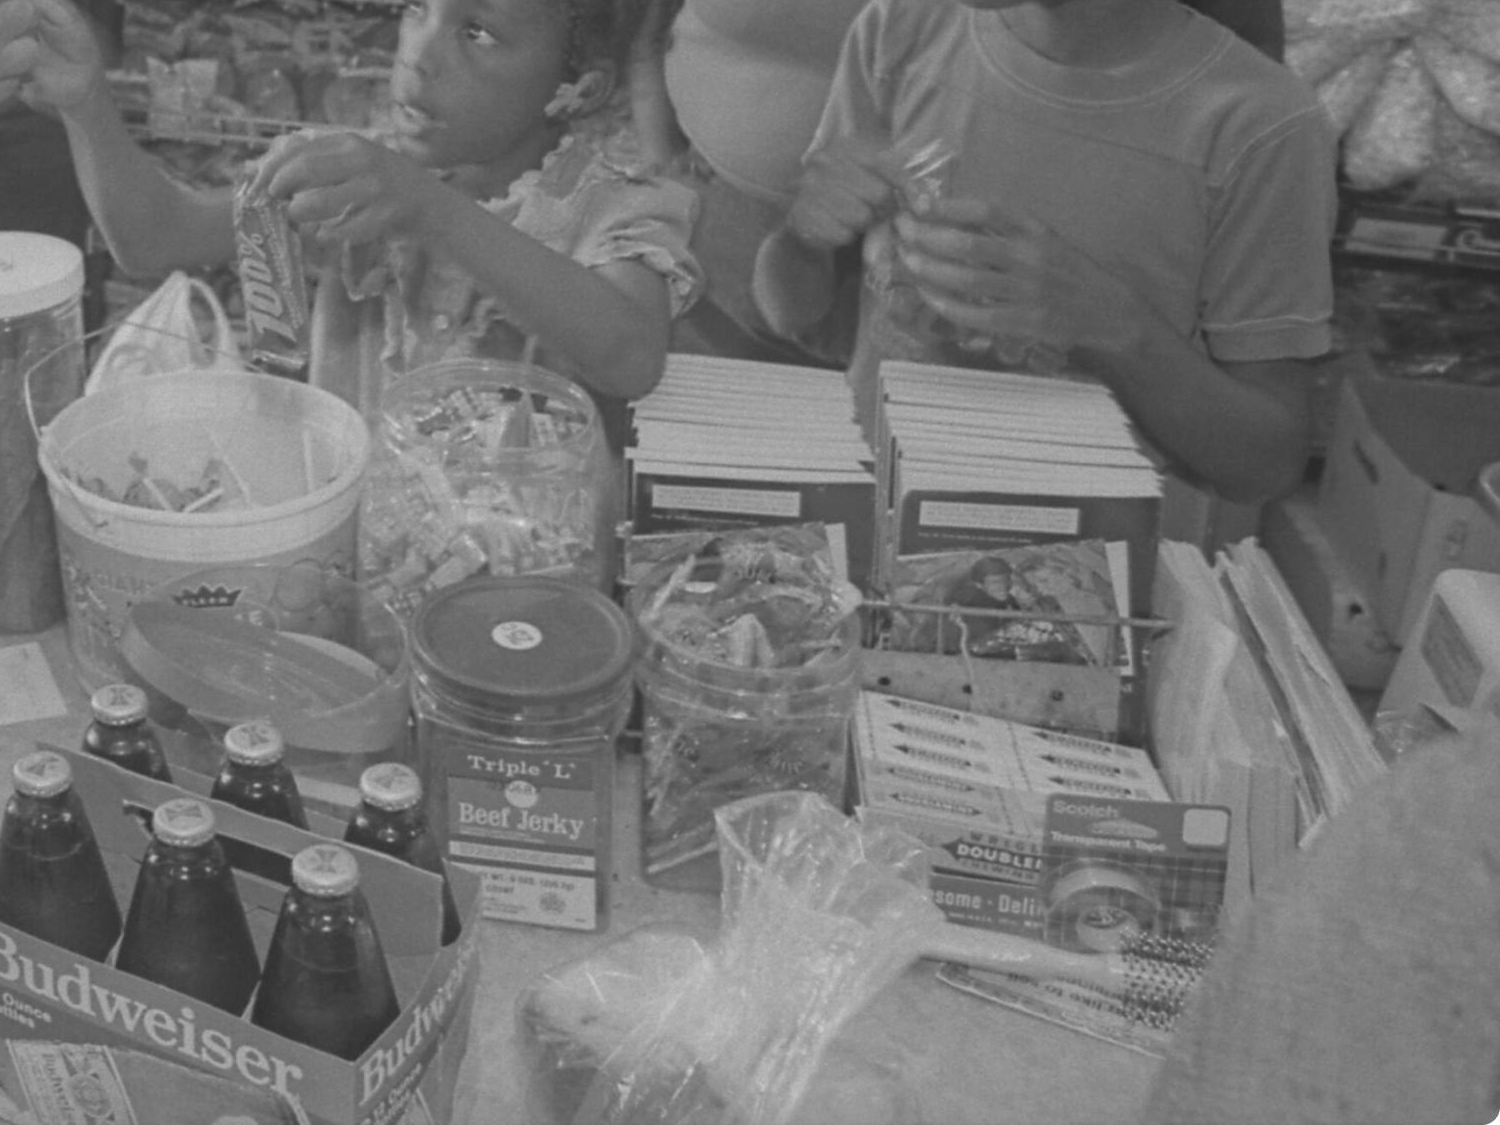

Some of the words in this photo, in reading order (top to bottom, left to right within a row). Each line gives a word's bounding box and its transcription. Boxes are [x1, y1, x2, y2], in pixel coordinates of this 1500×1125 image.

[466, 753, 541, 779] Triple
[458, 801, 512, 828] Beef
[517, 810, 585, 841] Jerky
[1053, 800, 1119, 819] Scotch
[1134, 839, 1167, 853] Tape
[2, 992, 52, 1024] Ounce
